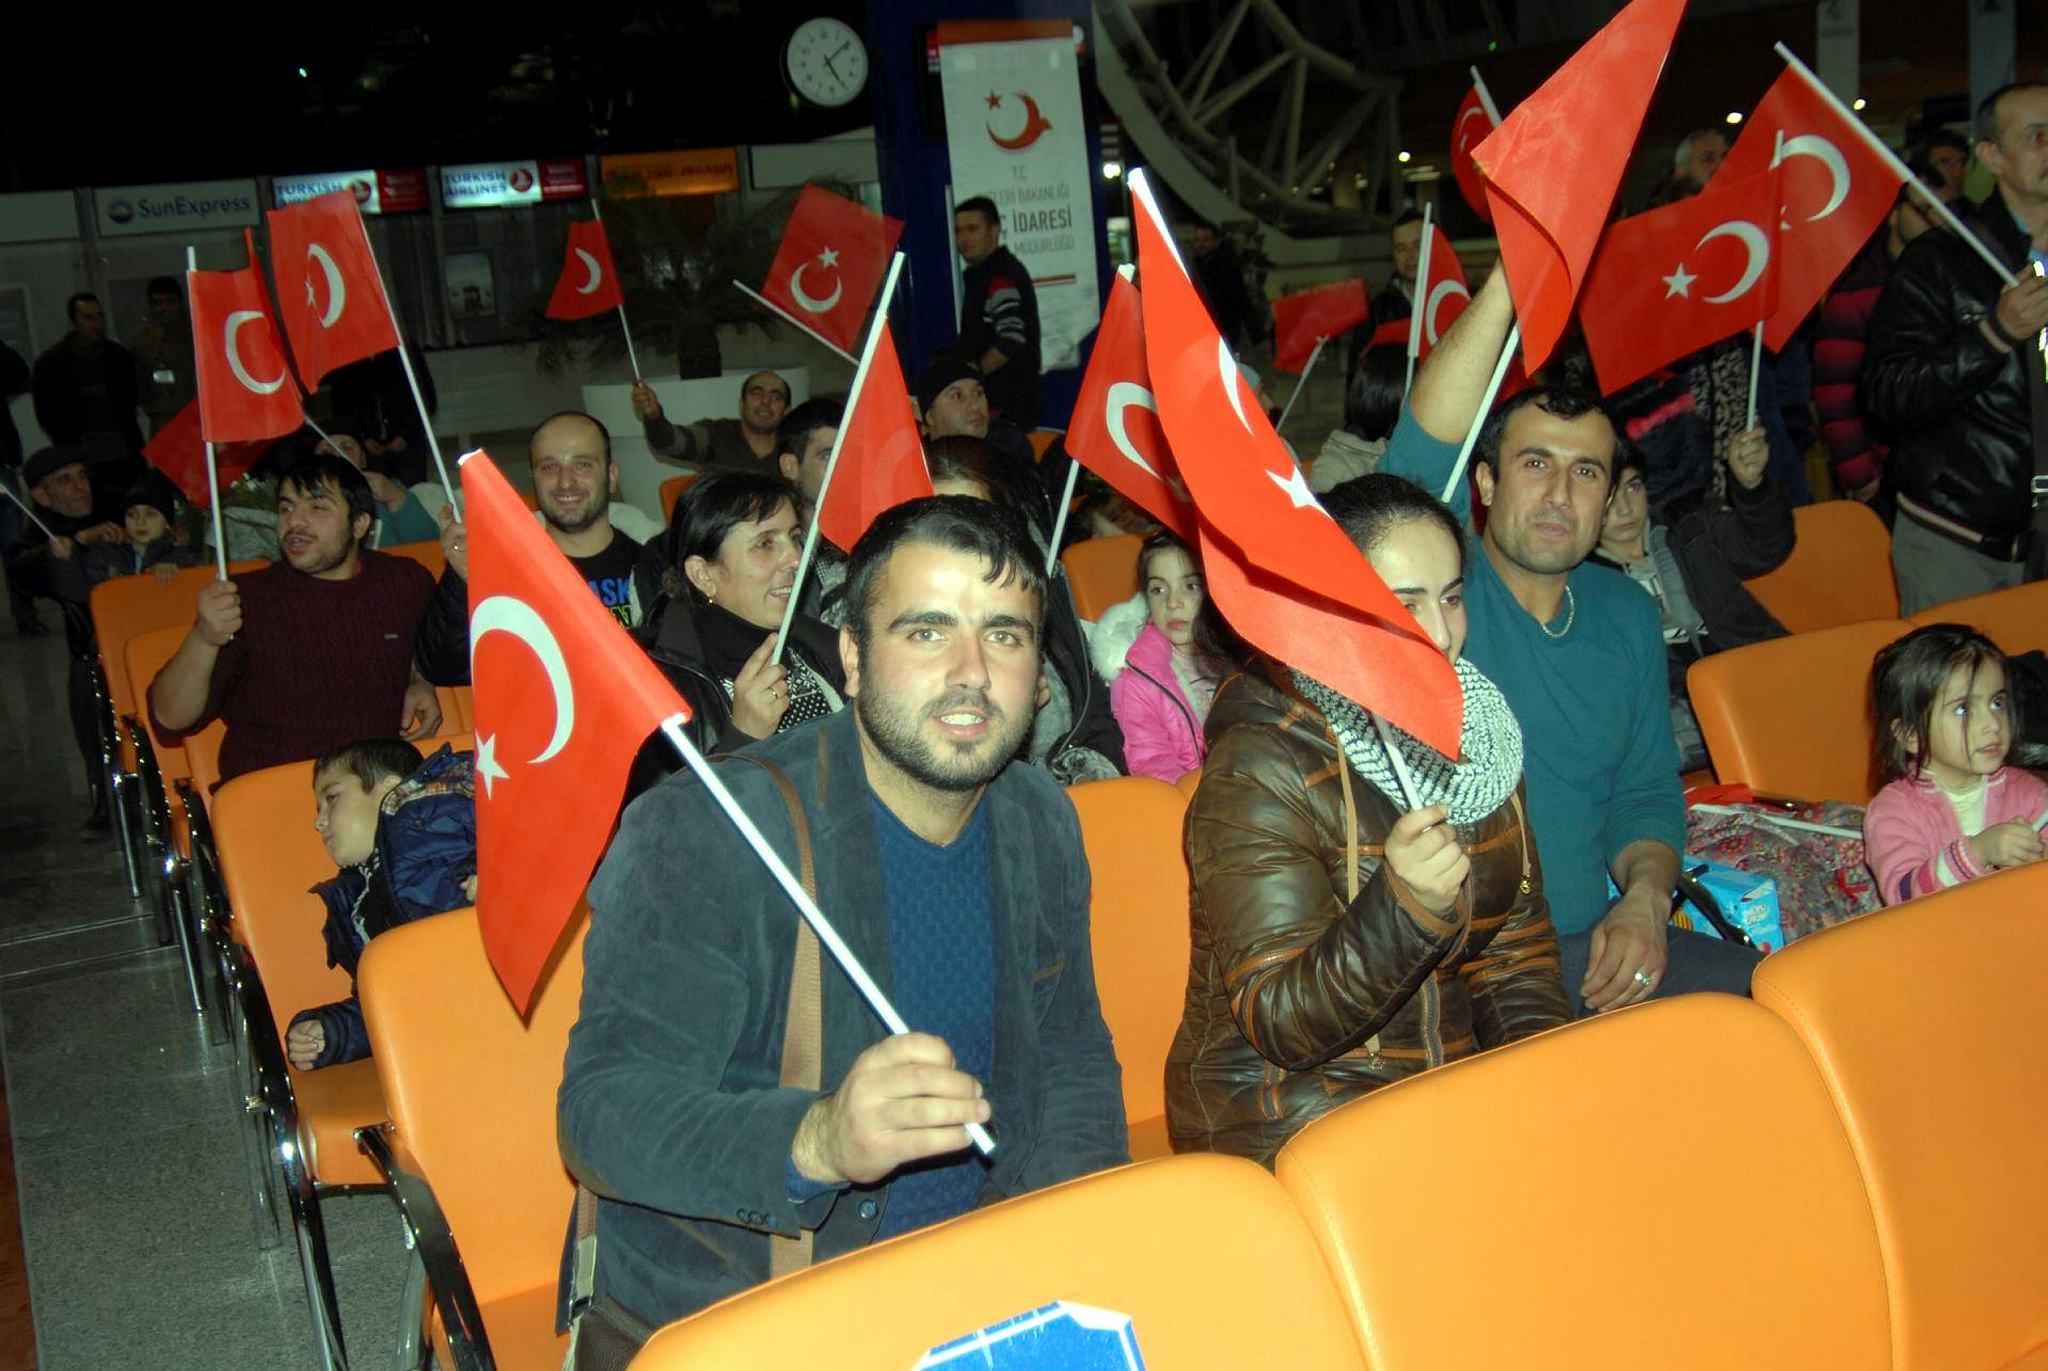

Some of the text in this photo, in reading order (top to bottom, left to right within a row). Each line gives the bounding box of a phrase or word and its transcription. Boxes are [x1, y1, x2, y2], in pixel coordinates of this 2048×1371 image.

[447, 169, 507, 184] TURKISH
[446, 182, 507, 198] AIRLINES
[137, 196, 251, 219] SunExpress
[1012, 203, 1072, 233] İDARESİ
